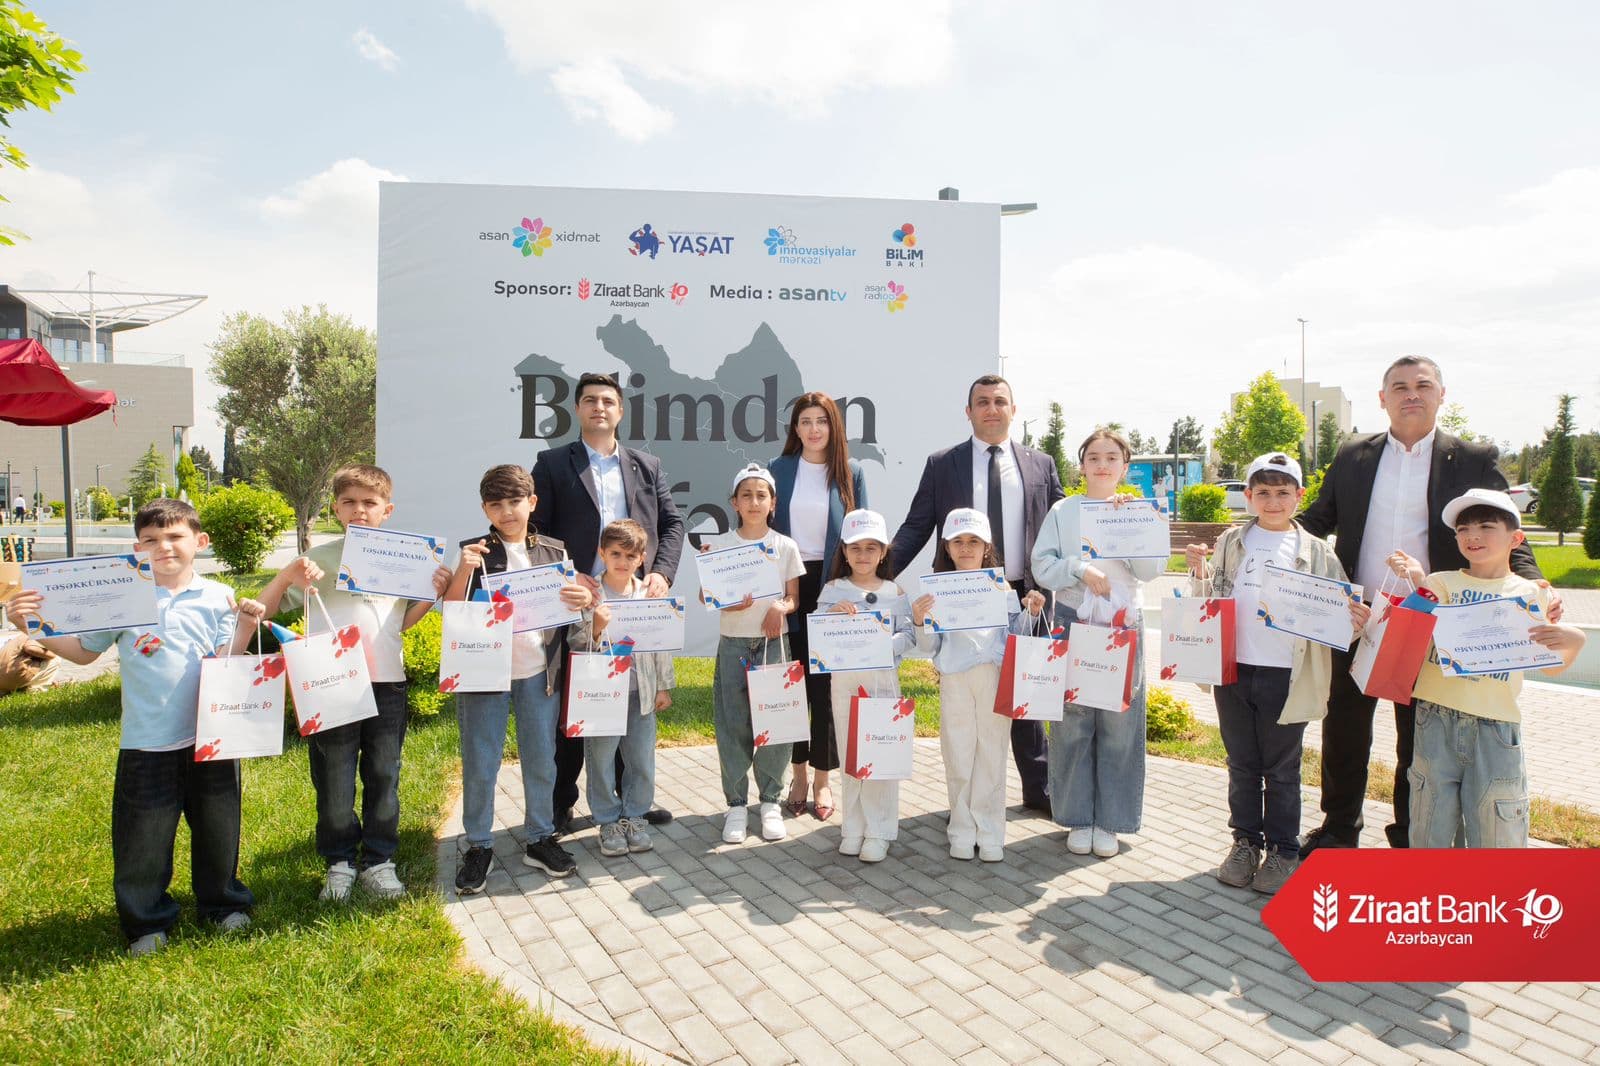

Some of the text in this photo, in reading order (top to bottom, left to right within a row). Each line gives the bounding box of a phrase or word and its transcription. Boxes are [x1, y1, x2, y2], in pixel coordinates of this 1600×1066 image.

[479, 231, 510, 241] asan
[668, 235, 735, 256] YAŞAT
[780, 246, 857, 258] innovasiyalar
[494, 280, 572, 297] Sponsor:
[594, 283, 631, 297] Ziraat
[634, 284, 665, 298] Bank
[710, 285, 763, 299] Media
[610, 300, 650, 308] Azərbaycan
[519, 372, 878, 444] Bimdn
[45, 577, 134, 592] TƏŞƏKKÜRNAMƏ
